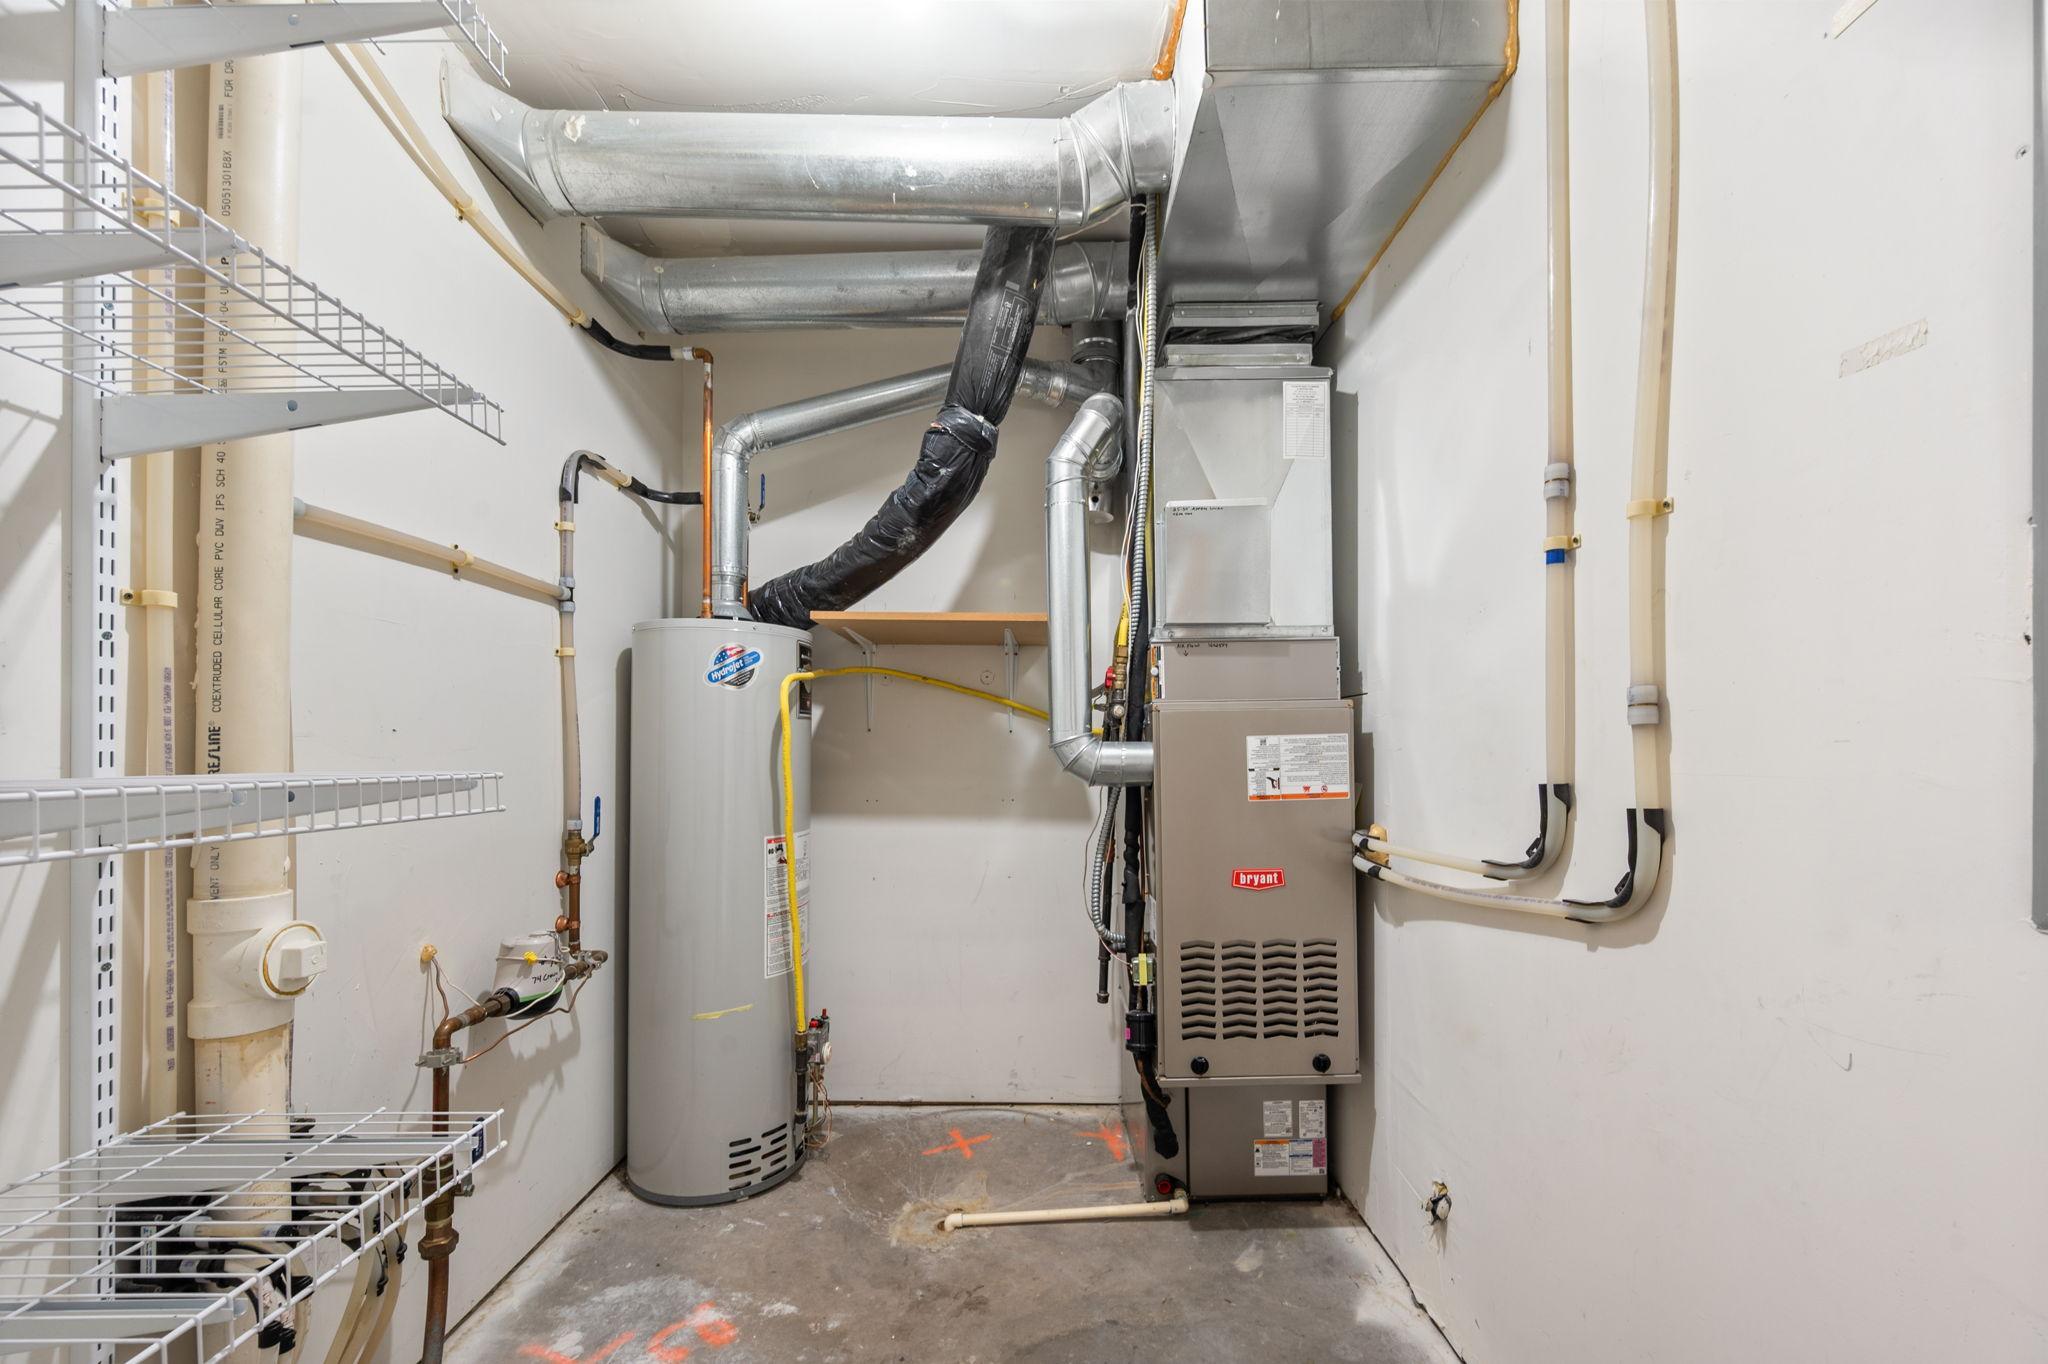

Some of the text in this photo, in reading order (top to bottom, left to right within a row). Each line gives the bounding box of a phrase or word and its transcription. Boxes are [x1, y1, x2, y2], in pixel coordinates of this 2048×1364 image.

[224, 79, 234, 98] FOR
[216, 451, 226, 464] 40
[216, 469, 226, 488] SCH
[215, 494, 225, 511] IPS
[215, 517, 225, 536] DWV
[215, 542, 225, 561] PVC
[214, 566, 224, 591] CORE
[213, 596, 224, 645] CELLULAR
[711, 659, 744, 681] Hydrojet
[211, 651, 223, 713] COEXTRUDED
[209, 846, 220, 900] VENT ONLY
[1240, 872, 1279, 886] bryant
